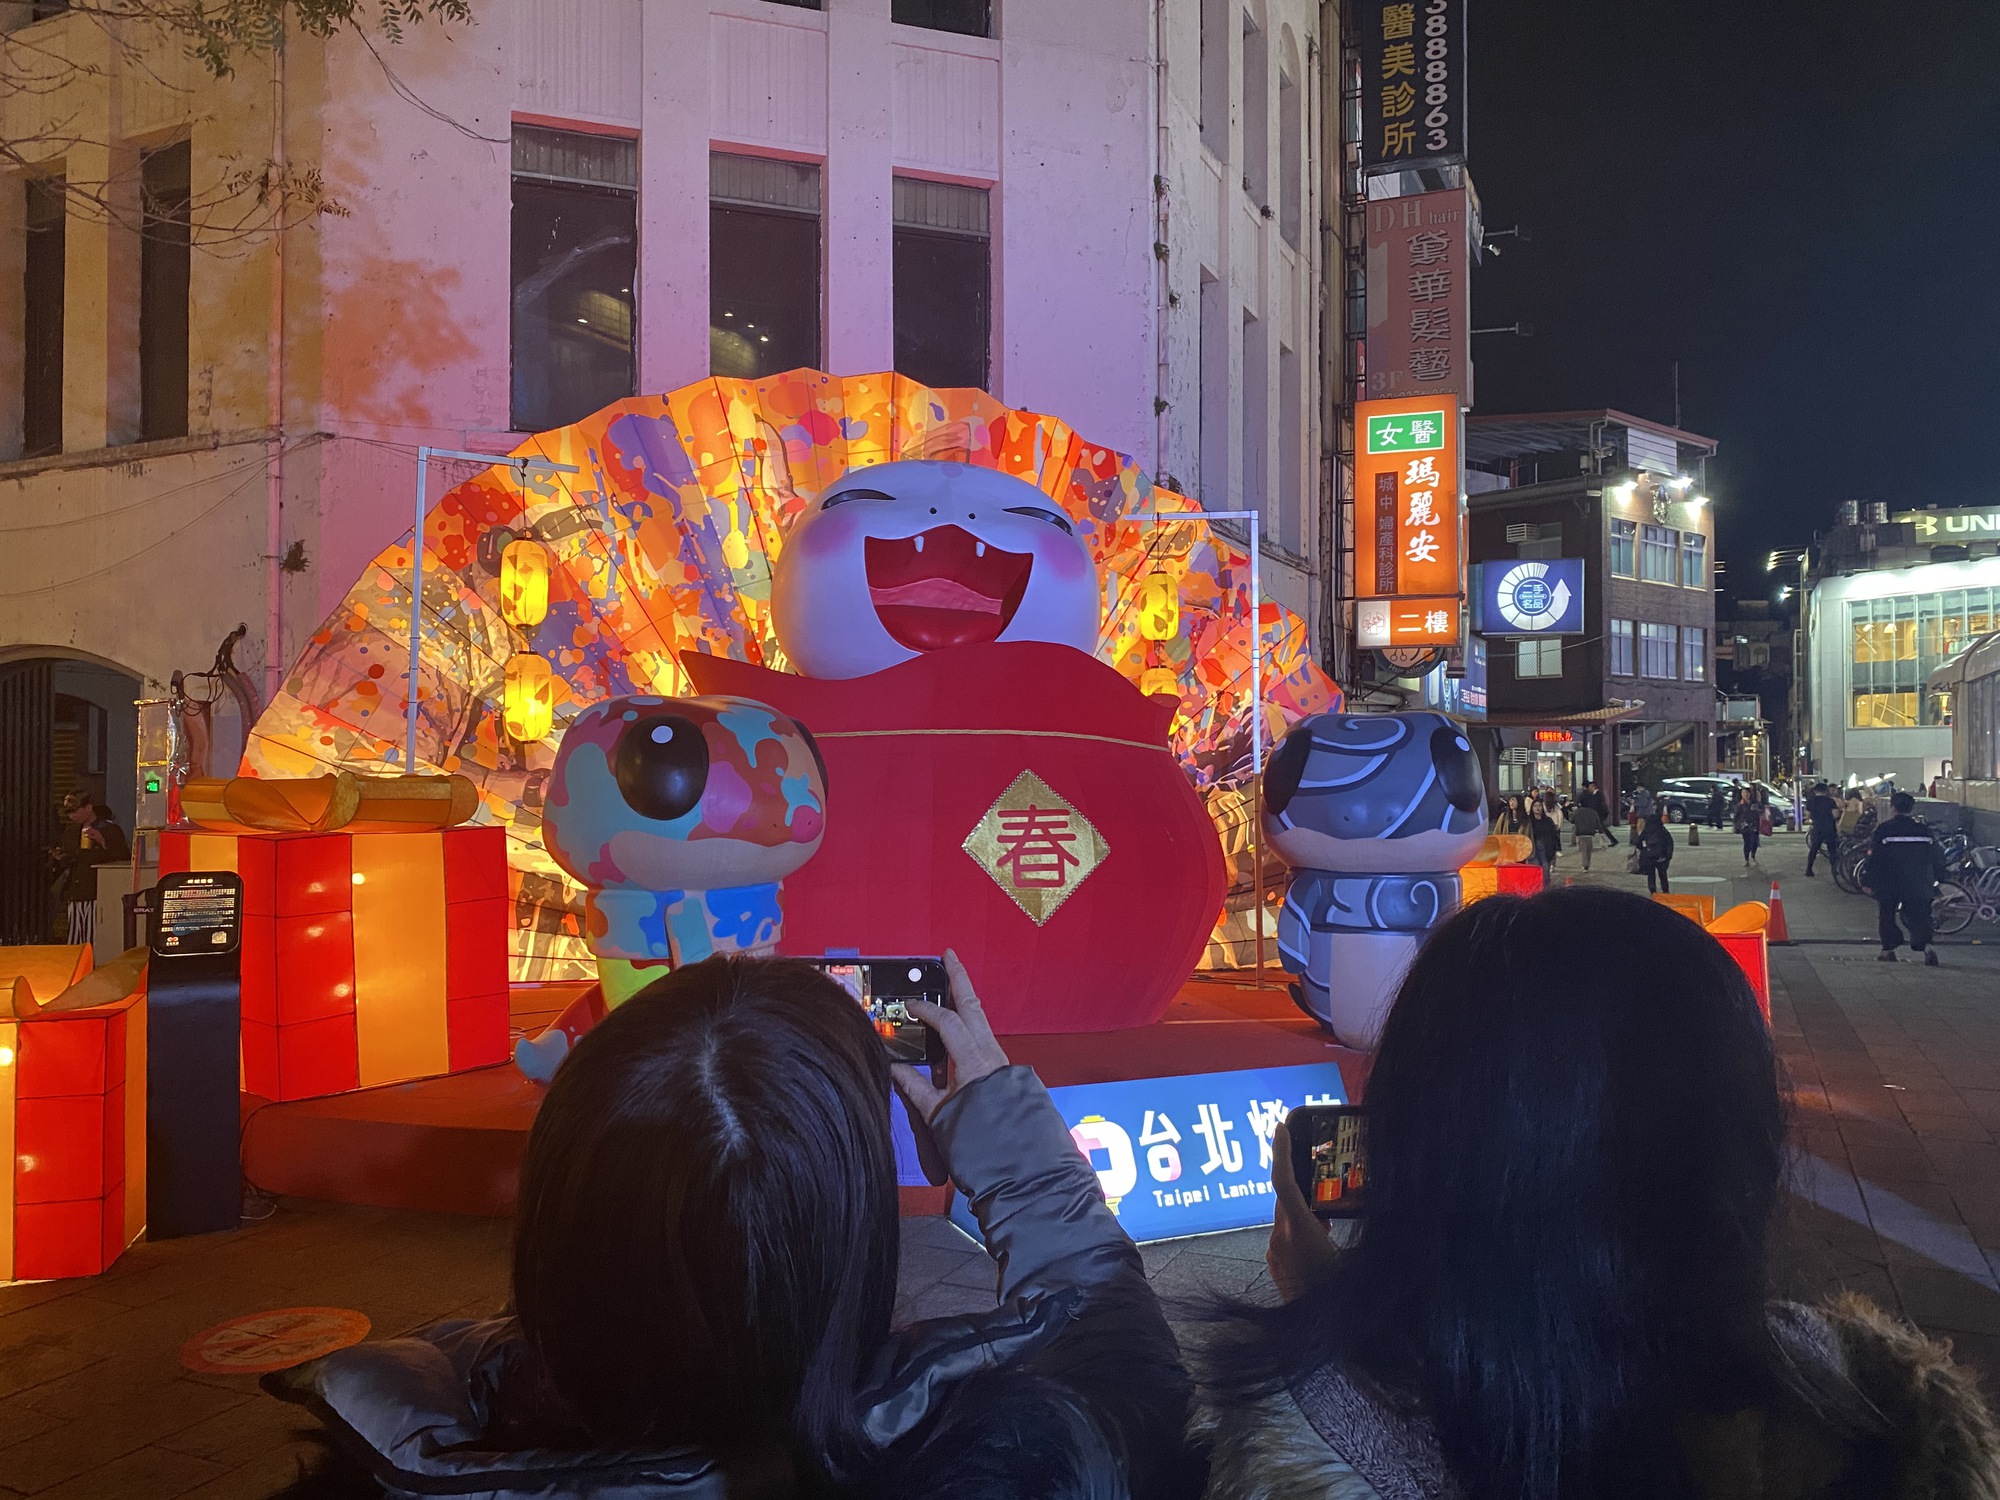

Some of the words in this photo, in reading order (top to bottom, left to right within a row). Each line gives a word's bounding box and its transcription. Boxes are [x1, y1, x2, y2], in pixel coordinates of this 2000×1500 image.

[1381, 2, 1416, 158] 醫美診所
[1429, 208, 1460, 225] hair
[1372, 370, 1403, 391] 3F
[1376, 419, 1437, 447] 女醫
[1404, 456, 1440, 562] 瑪麗安
[1945, 513, 2000, 533] UN
[1523, 584, 1543, 594] 二手
[1523, 599, 1543, 608] 名品
[1398, 610, 1449, 634] 二樓
[997, 803, 1080, 889] 春
[1152, 1185, 1211, 1208] Taipei
